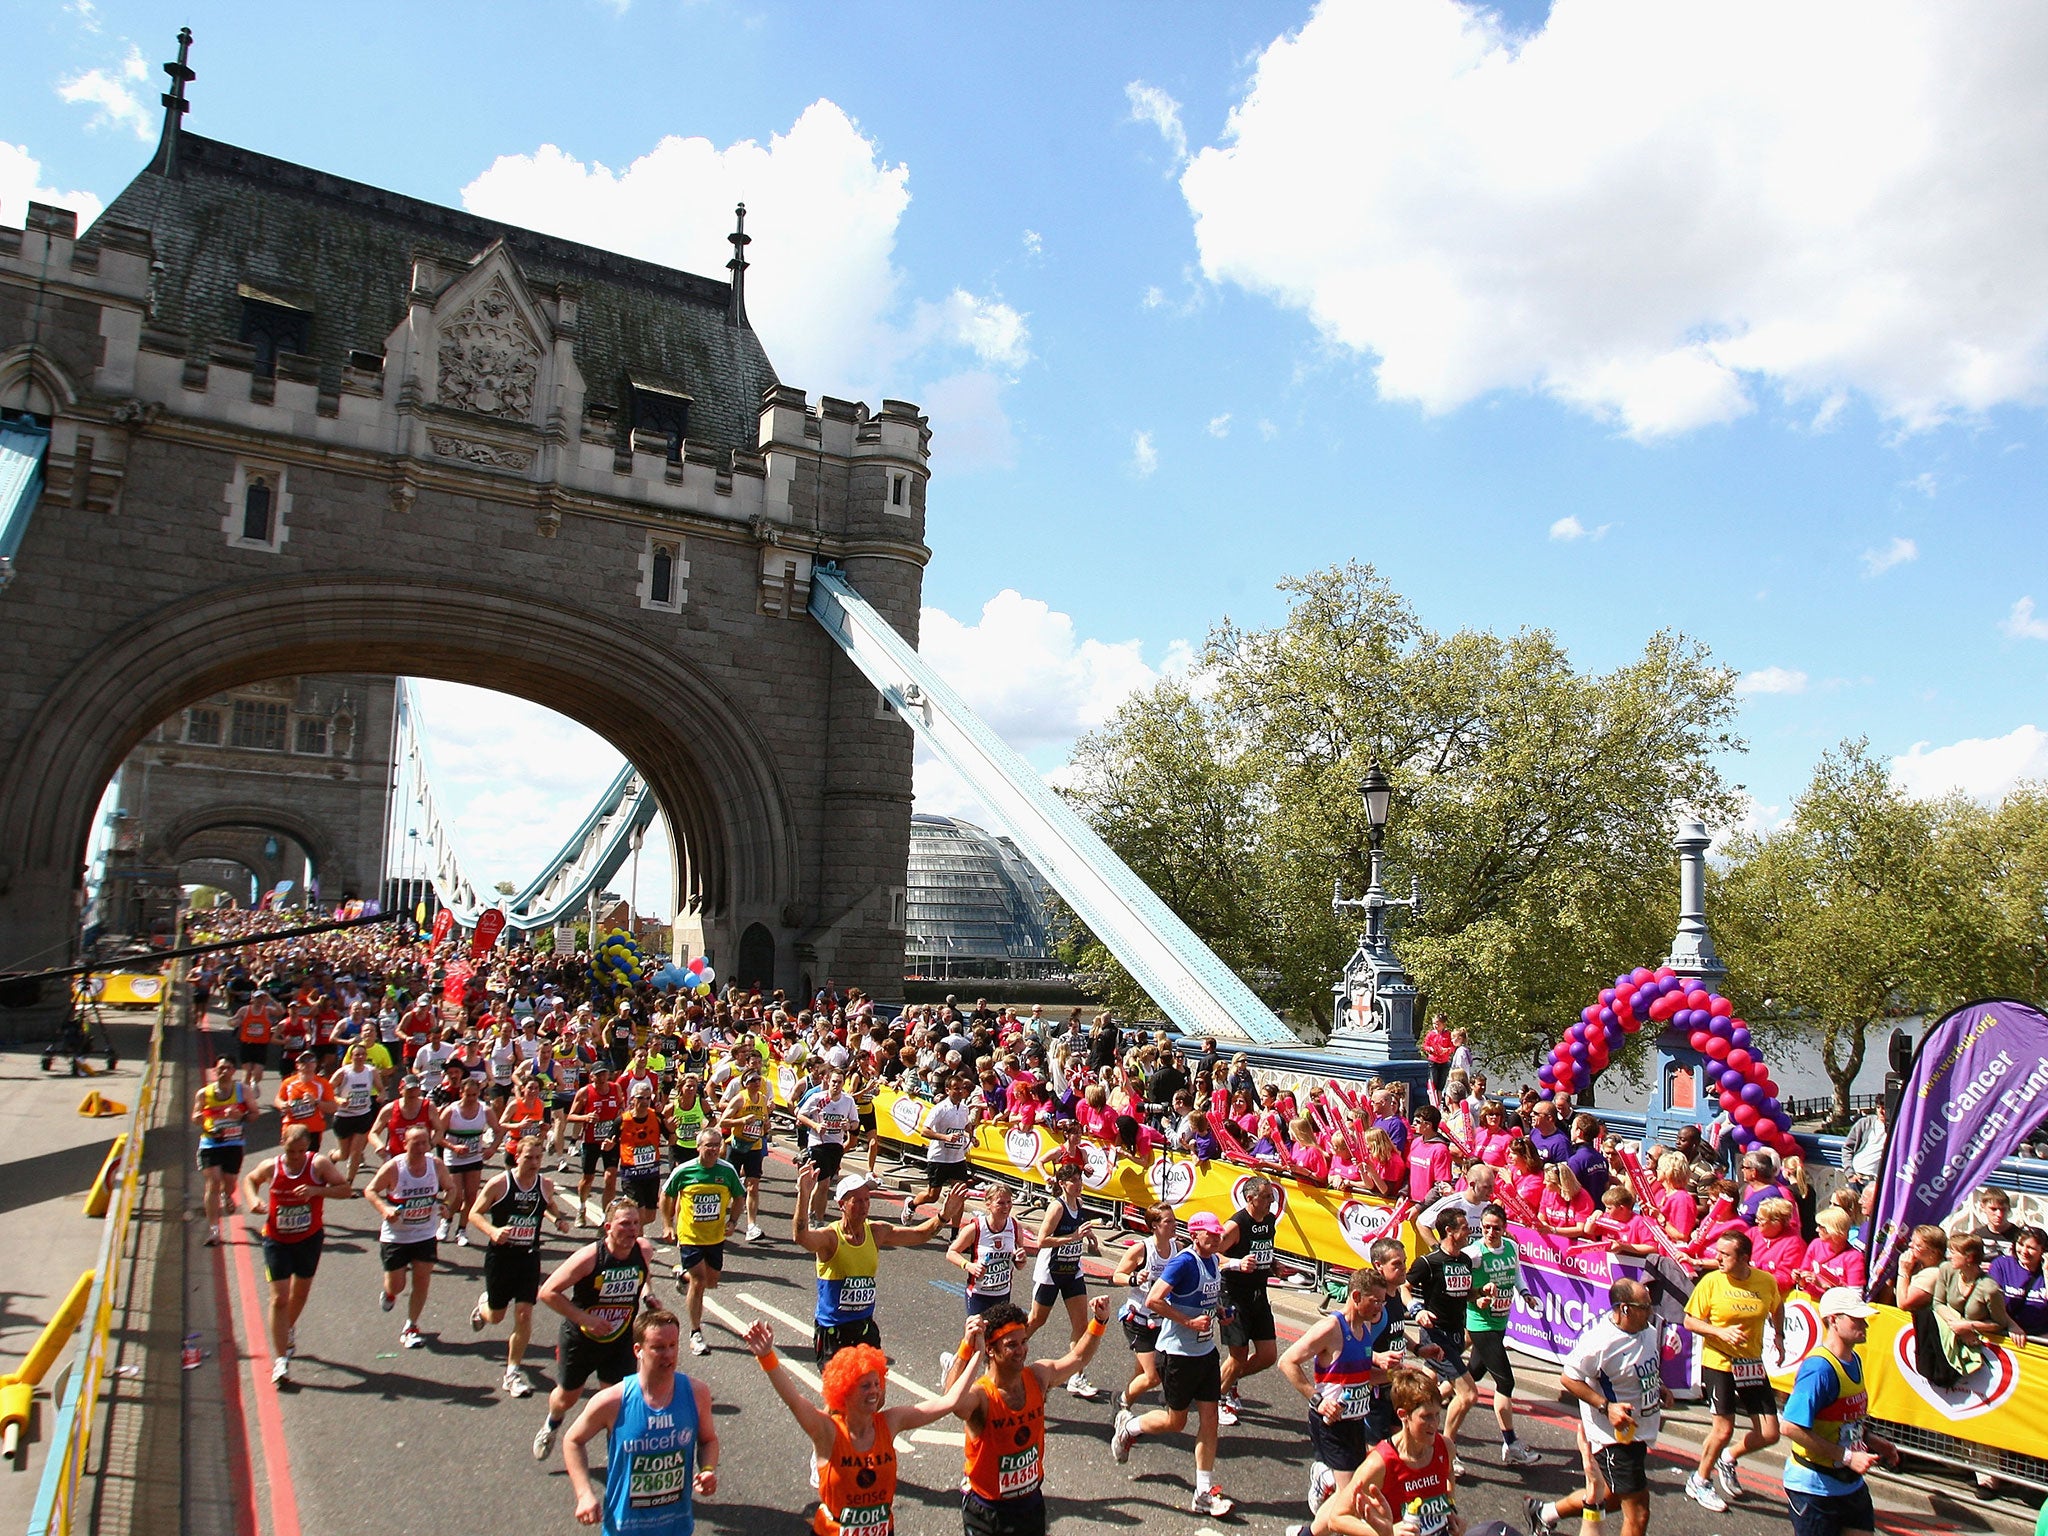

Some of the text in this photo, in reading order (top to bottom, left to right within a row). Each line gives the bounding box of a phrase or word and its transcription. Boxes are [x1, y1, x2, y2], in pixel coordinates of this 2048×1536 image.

[1896, 1049, 2014, 1185] World Cancer
[1914, 1056, 2048, 1207] Research Fund
[1157, 1166, 1187, 1181] FORA
[402, 1186, 435, 1197] SPEEDY
[694, 1193, 720, 1203] FLORA
[695, 1203, 718, 1215] 5567
[1347, 1209, 1387, 1228] FLORA
[1251, 1224, 1269, 1234] Gary
[604, 1266, 639, 1281] FLORA
[988, 1260, 1010, 1274] LORA
[1445, 1264, 1471, 1275] FLORA
[605, 1281, 635, 1295] 2839
[843, 1277, 875, 1288] FLORA
[840, 1289, 875, 1303] 24982
[1515, 1322, 1551, 1341] national
[647, 1414, 674, 1430] PHIL
[623, 1430, 677, 1453] unicef
[633, 1451, 684, 1472] FLORA
[841, 1453, 892, 1468] MARIA
[1001, 1446, 1038, 1470] FLORA
[631, 1467, 684, 1493] 28692
[1404, 1474, 1440, 1492] RACHEL
[845, 1489, 887, 1506] sense
[841, 1504, 887, 1525] FLORA
